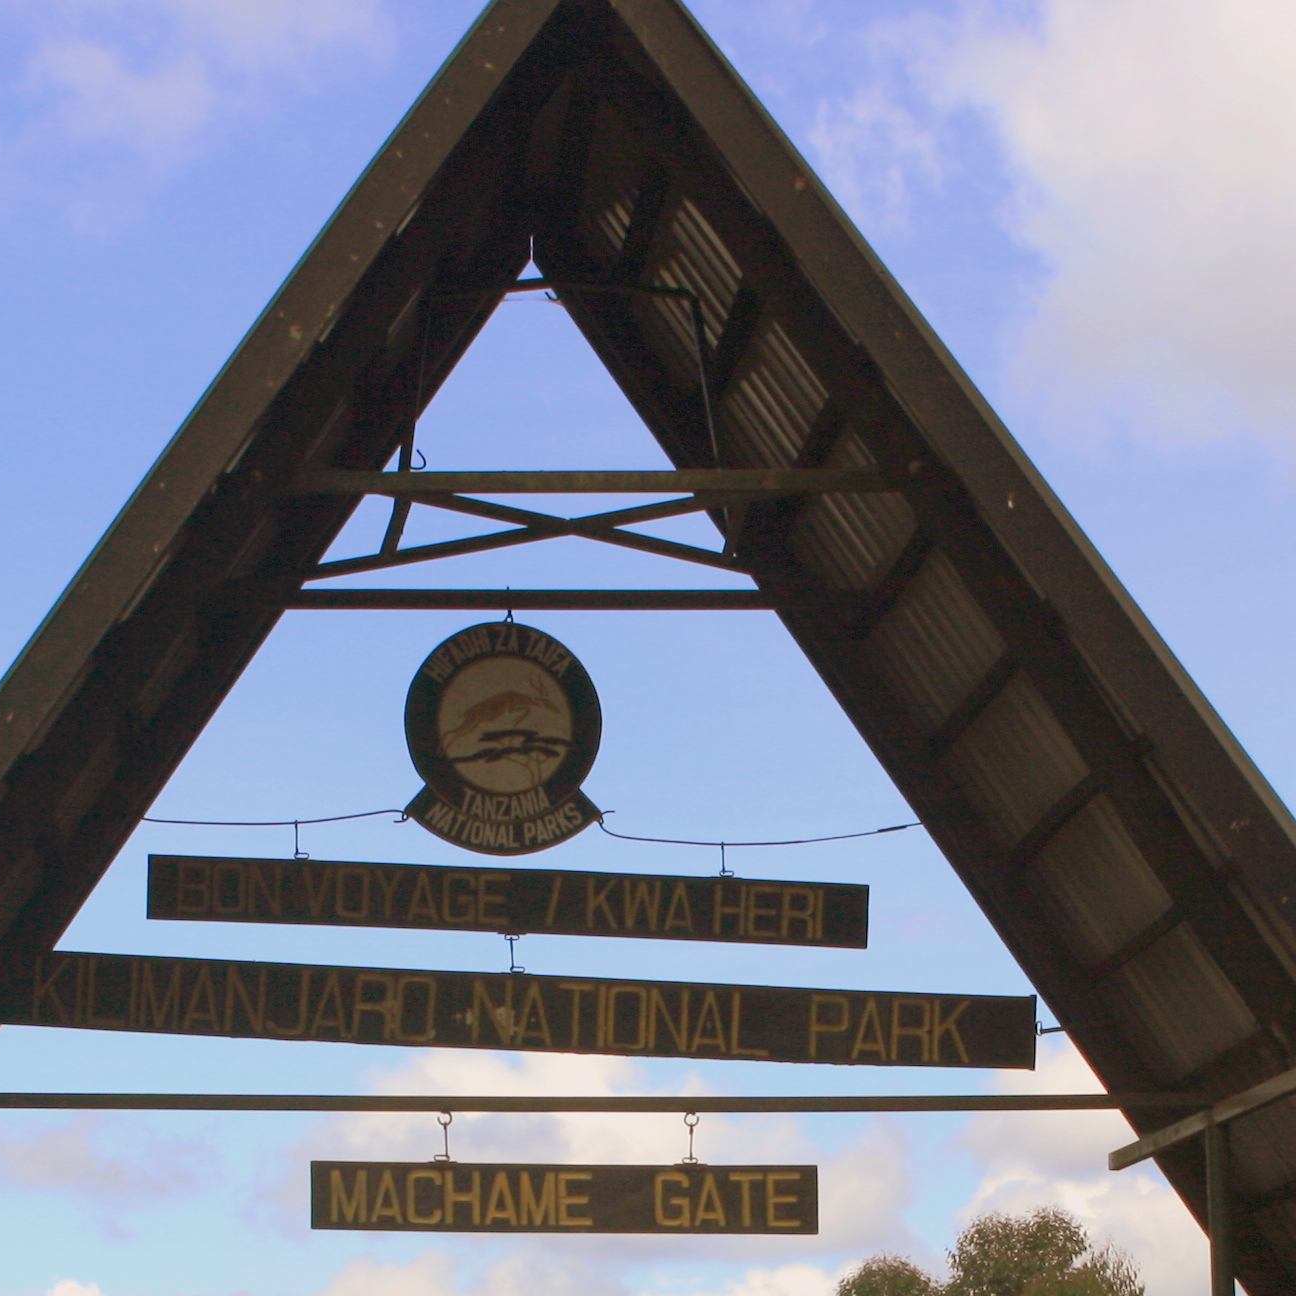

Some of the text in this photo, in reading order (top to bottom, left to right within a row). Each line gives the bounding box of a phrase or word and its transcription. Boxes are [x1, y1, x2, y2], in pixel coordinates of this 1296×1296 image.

[423, 626, 574, 684] HIFADHI ZA TAIFA
[424, 801, 583, 848] NATIONAL PARKS
[463, 786, 551, 821] TANZANIA
[176, 861, 282, 917] BON
[302, 866, 511, 927] VOYAGE
[585, 877, 695, 935] KWA
[712, 883, 823, 942] HERI
[31, 955, 971, 1065] KILIMANJARO NATIONAL PARK
[329, 1168, 802, 1229] MACHAME GATE
